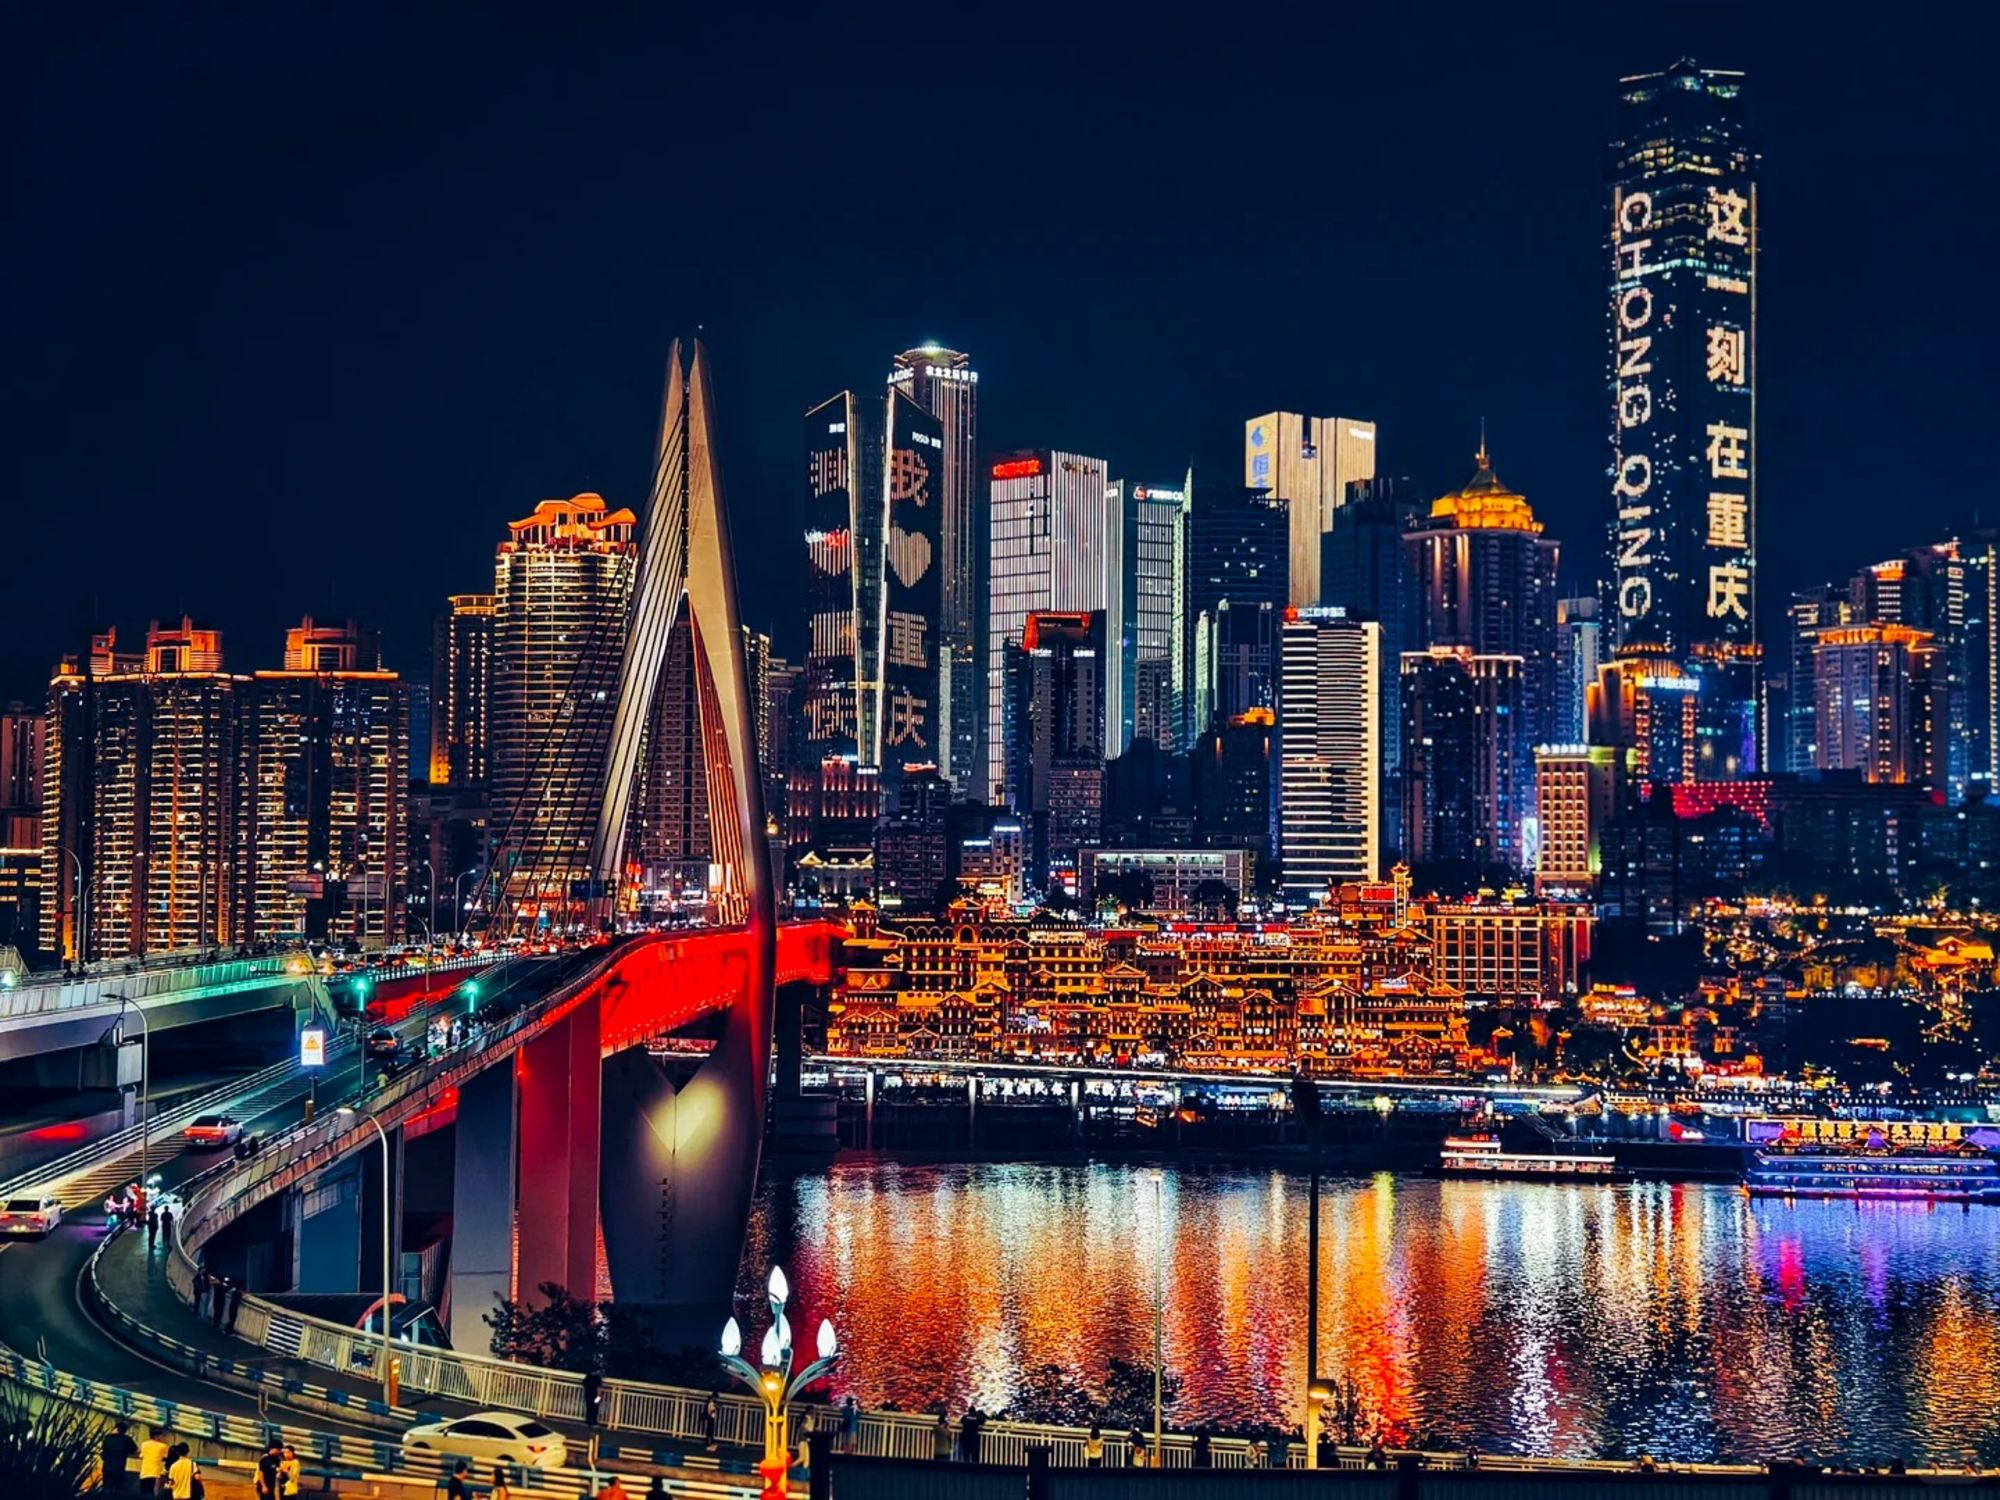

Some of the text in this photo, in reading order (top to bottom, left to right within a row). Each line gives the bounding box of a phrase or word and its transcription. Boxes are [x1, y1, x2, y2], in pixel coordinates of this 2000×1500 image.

[1611, 192, 1652, 617] CHONG QING
[1706, 186, 1748, 620] 这一刻在重庆
